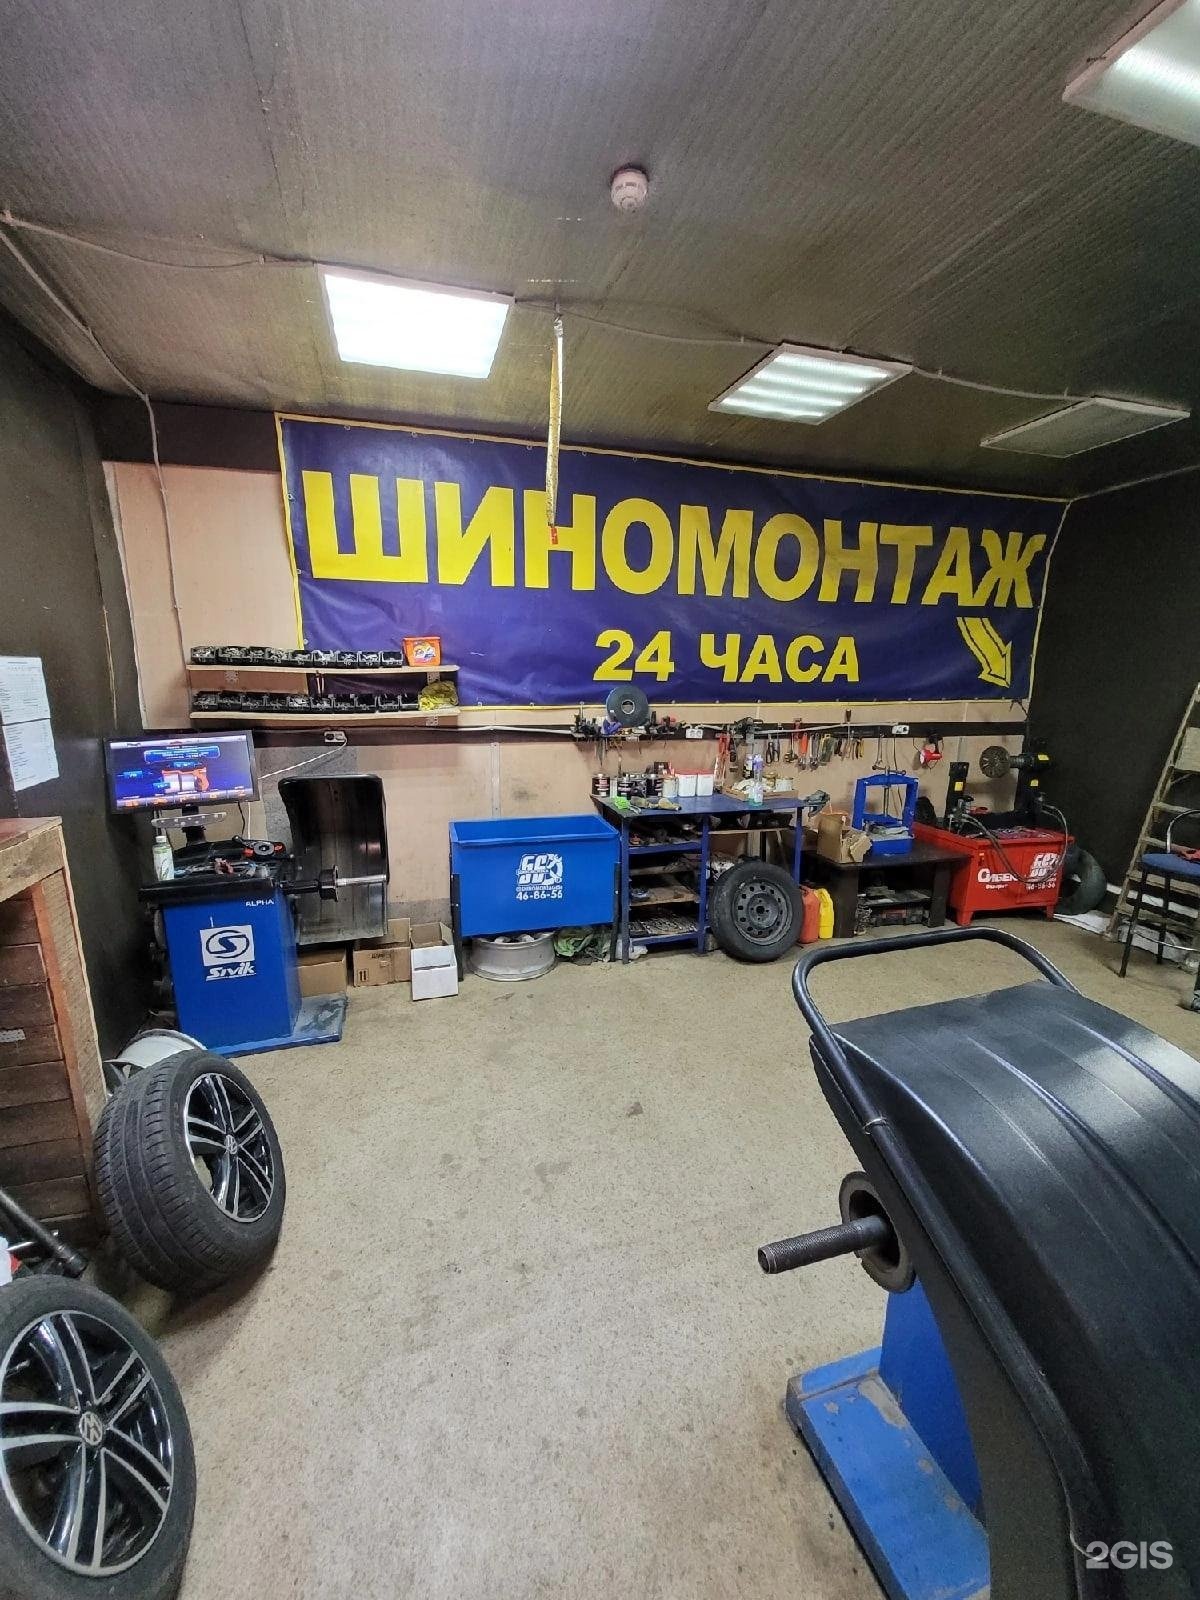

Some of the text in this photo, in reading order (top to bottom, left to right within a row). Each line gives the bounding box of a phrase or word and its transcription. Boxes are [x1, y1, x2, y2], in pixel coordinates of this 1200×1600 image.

[302, 470, 1046, 609] ШИНОМОНТАЖ
[593, 629, 859, 682] 24 ЧАСА
[245, 899, 275, 907] ALPHA
